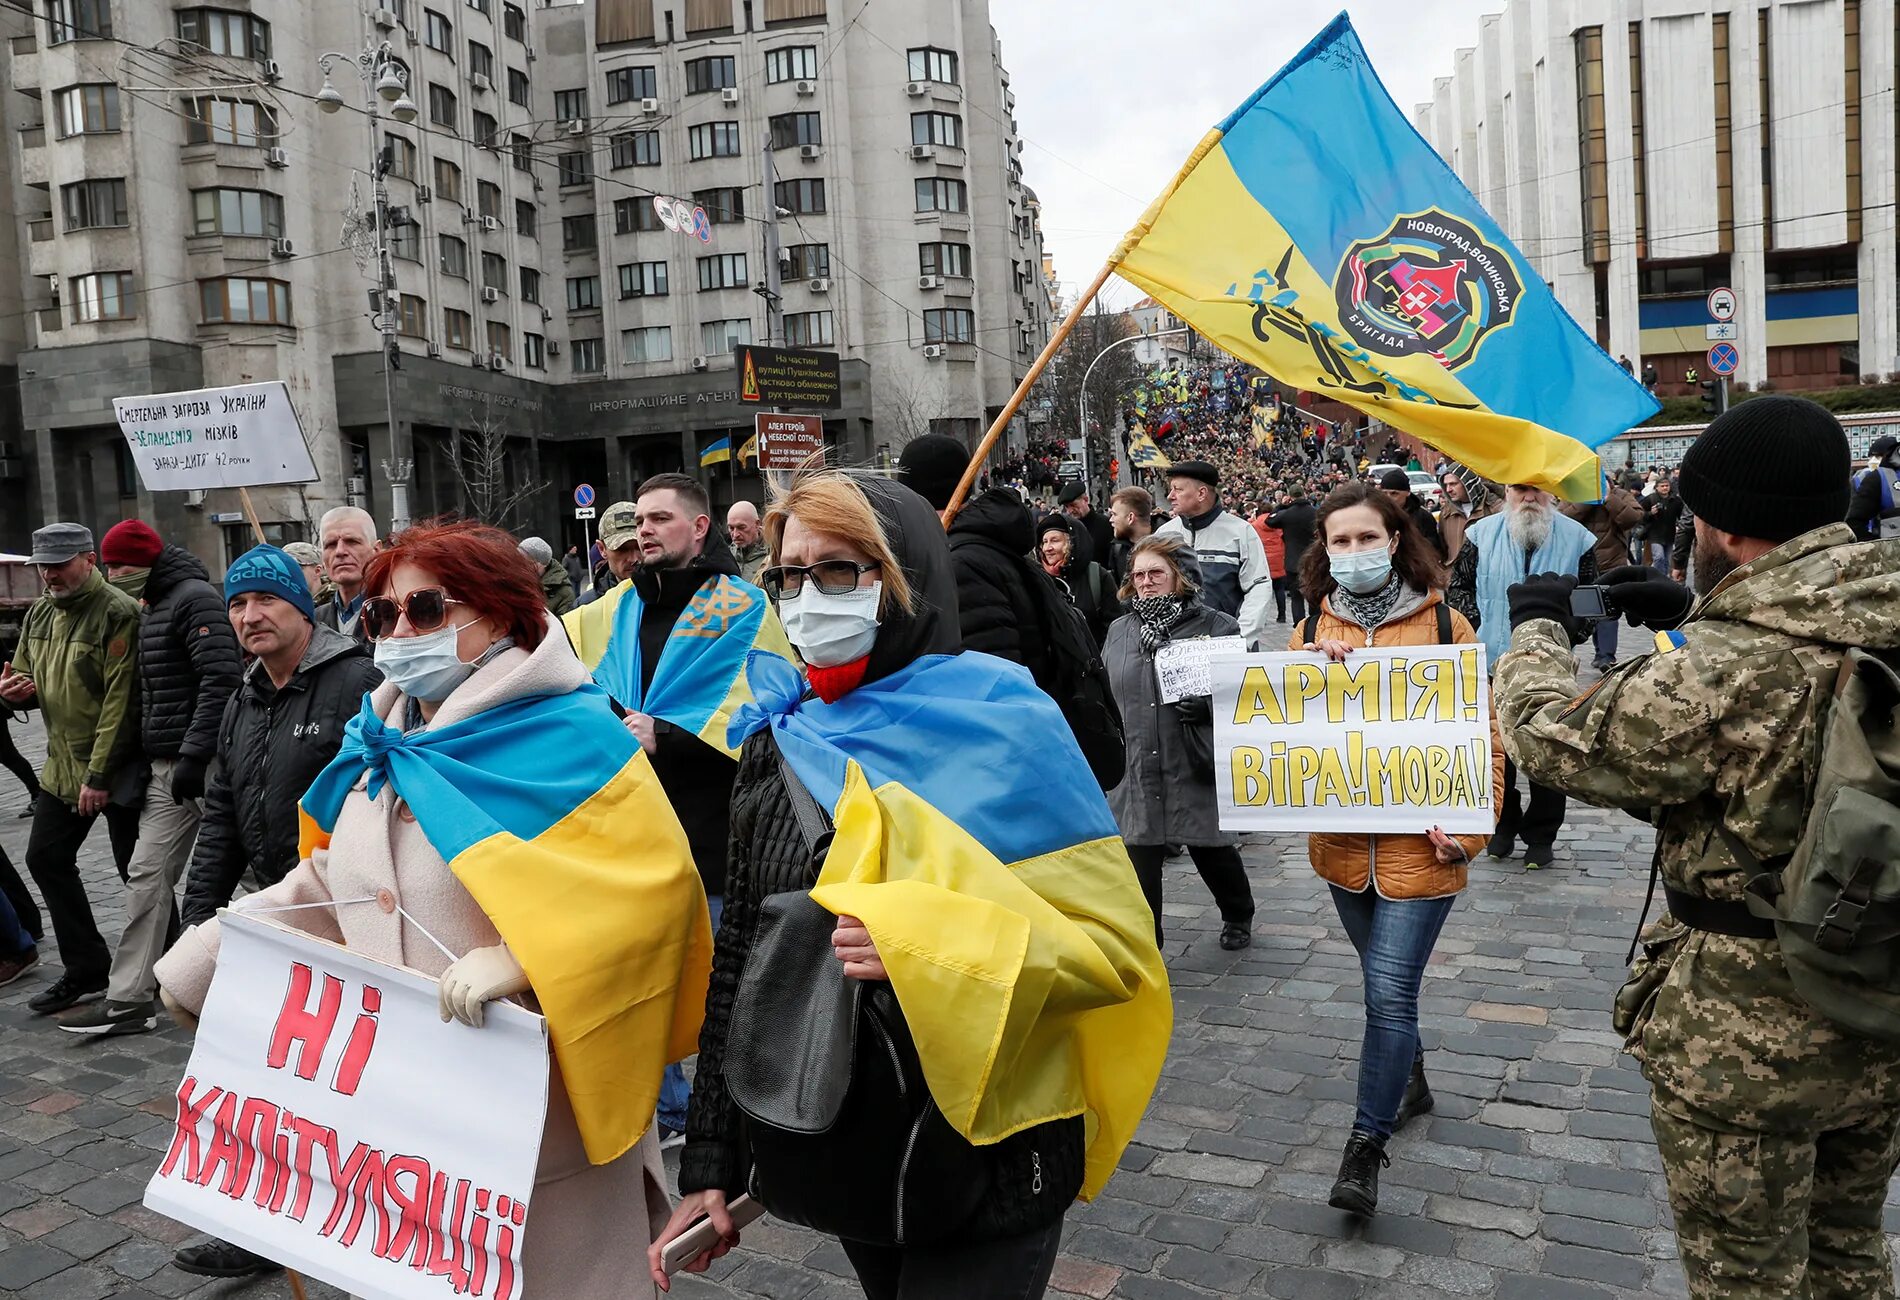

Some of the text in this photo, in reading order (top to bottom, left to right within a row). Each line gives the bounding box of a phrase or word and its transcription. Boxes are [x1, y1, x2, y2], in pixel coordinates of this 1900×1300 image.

[1407, 219, 1510, 313] НОВОГРАД-ВОЛИНСЬКА
[1349, 314, 1405, 349] БРИГАДА
[775, 354, 818, 365] На частині
[758, 366, 836, 379] вулиці Пушкінської
[757, 378, 838, 390] частково обмежено
[589, 393, 687, 412] ІНФОРМАЦІЙНЕ
[767, 391, 830, 403] рух транспорту
[172, 400, 211, 419] ЗАГРОЗА
[219, 393, 267, 414] УКРАЇНИ
[768, 421, 805, 432] АЛЕЯ ГЕРОЇВ
[768, 432, 814, 442] НЕБЕСНОЇ СОТНІ
[229, 566, 301, 594] adidas
[1162, 676, 1177, 688] НЕ
